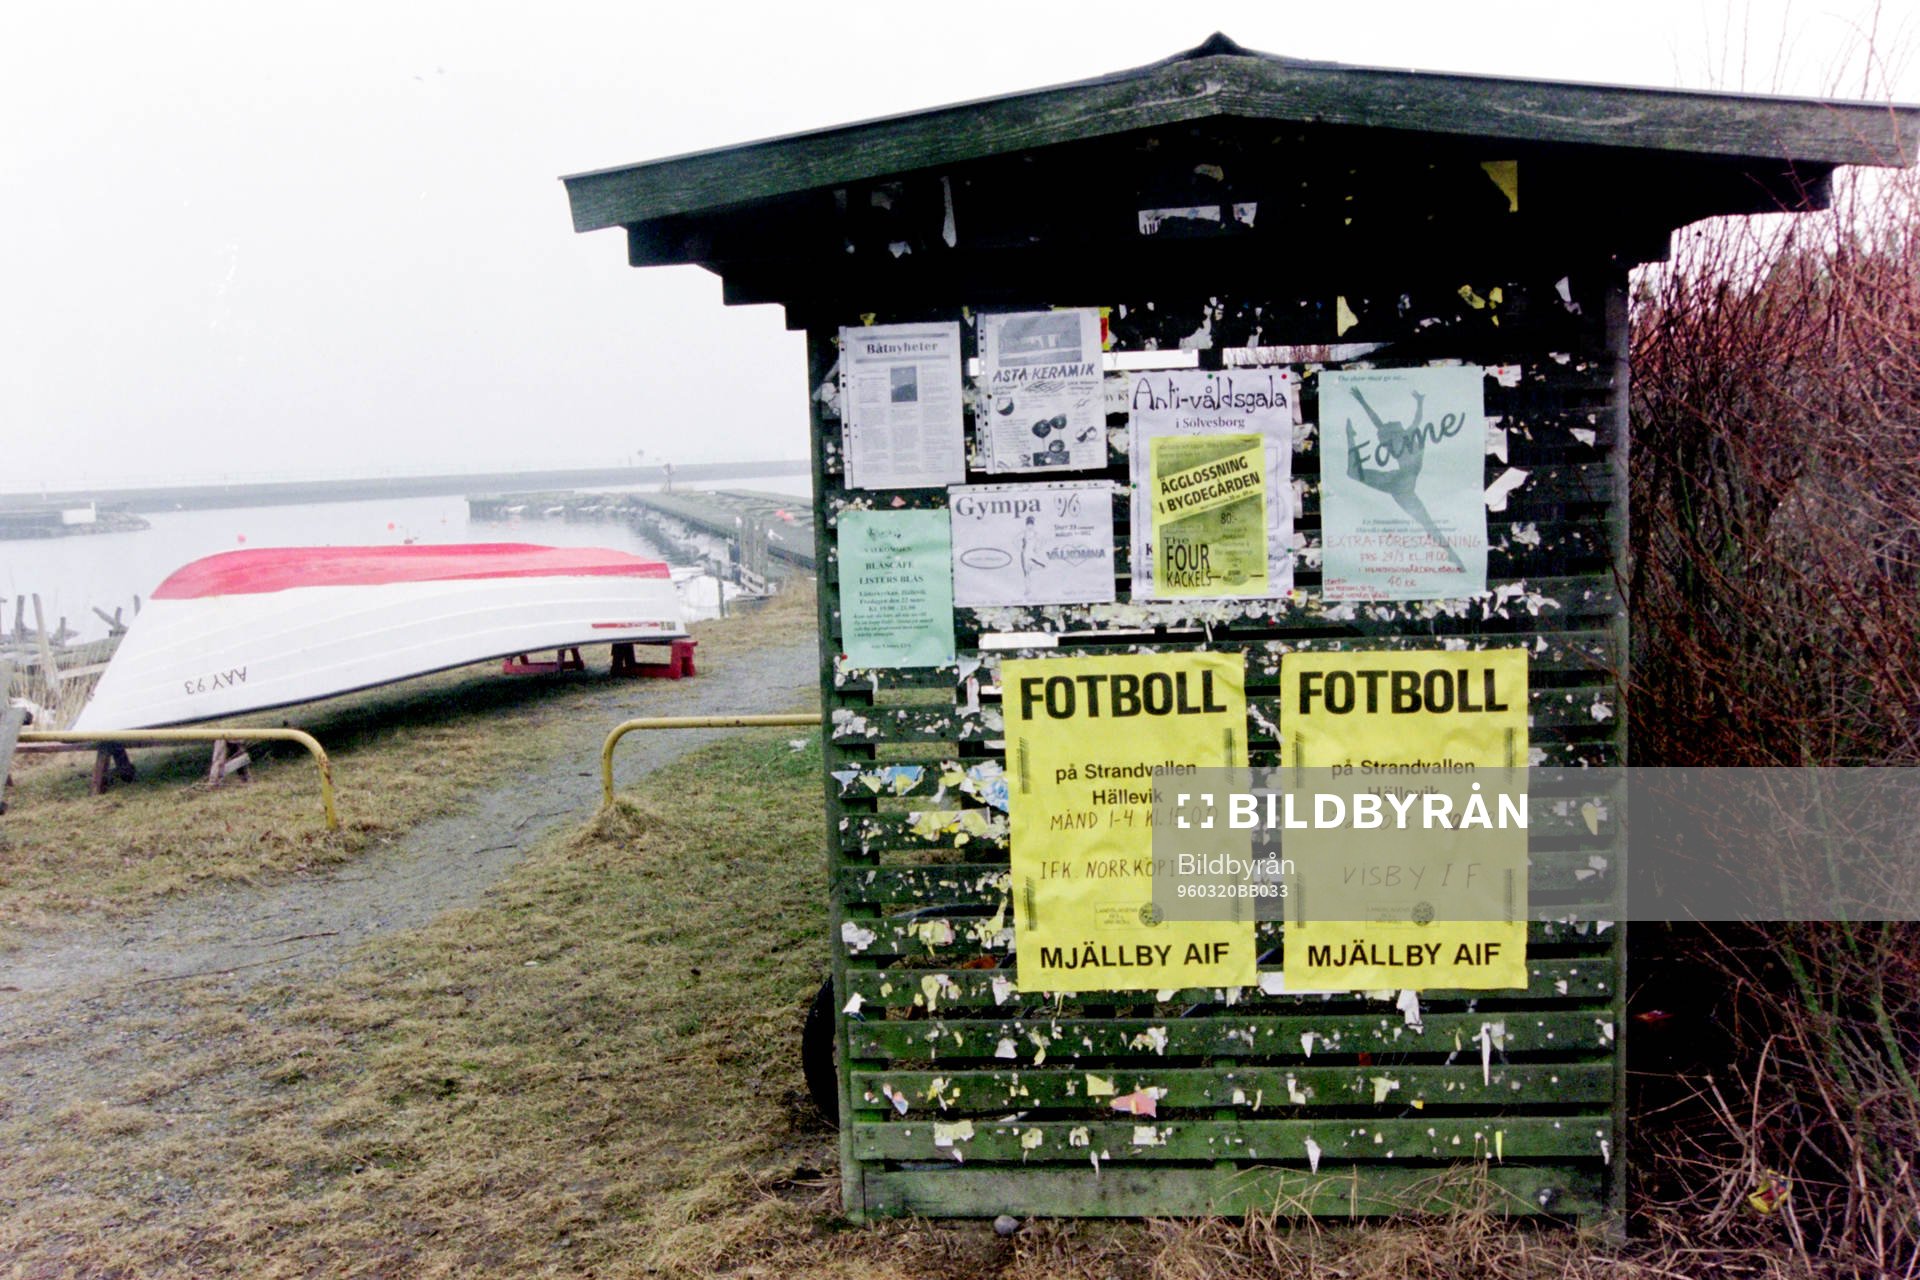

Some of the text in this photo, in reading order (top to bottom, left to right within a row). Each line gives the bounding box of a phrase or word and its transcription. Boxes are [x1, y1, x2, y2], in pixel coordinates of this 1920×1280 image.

[866, 341, 939, 355] Båtnyheter
[992, 363, 1095, 383] ASTA KERAMIK
[1132, 374, 1288, 414] Anti-våldsgala
[1348, 411, 1466, 482] Fame
[1160, 455, 1249, 496] ÄGGLOSSNING
[1158, 501, 1165, 515] I
[1166, 470, 1262, 512] BYGDEGÅRDEN
[955, 494, 1042, 521] Gympa
[1166, 544, 1210, 571] FOUR
[1166, 569, 1211, 588] KACKELS
[1020, 669, 1228, 721] FOTBOLL
[1299, 668, 1509, 716] FOTBOLL
[1055, 760, 1198, 785] på Strandvallen
[1331, 758, 1476, 781] på Strandvallen
[1092, 787, 1163, 806] Hällevik
[1040, 861, 1072, 881] IFK
[1040, 941, 1230, 969] MJÄLLBY AIF
[1308, 939, 1502, 967] MJÄLLBY AIF
